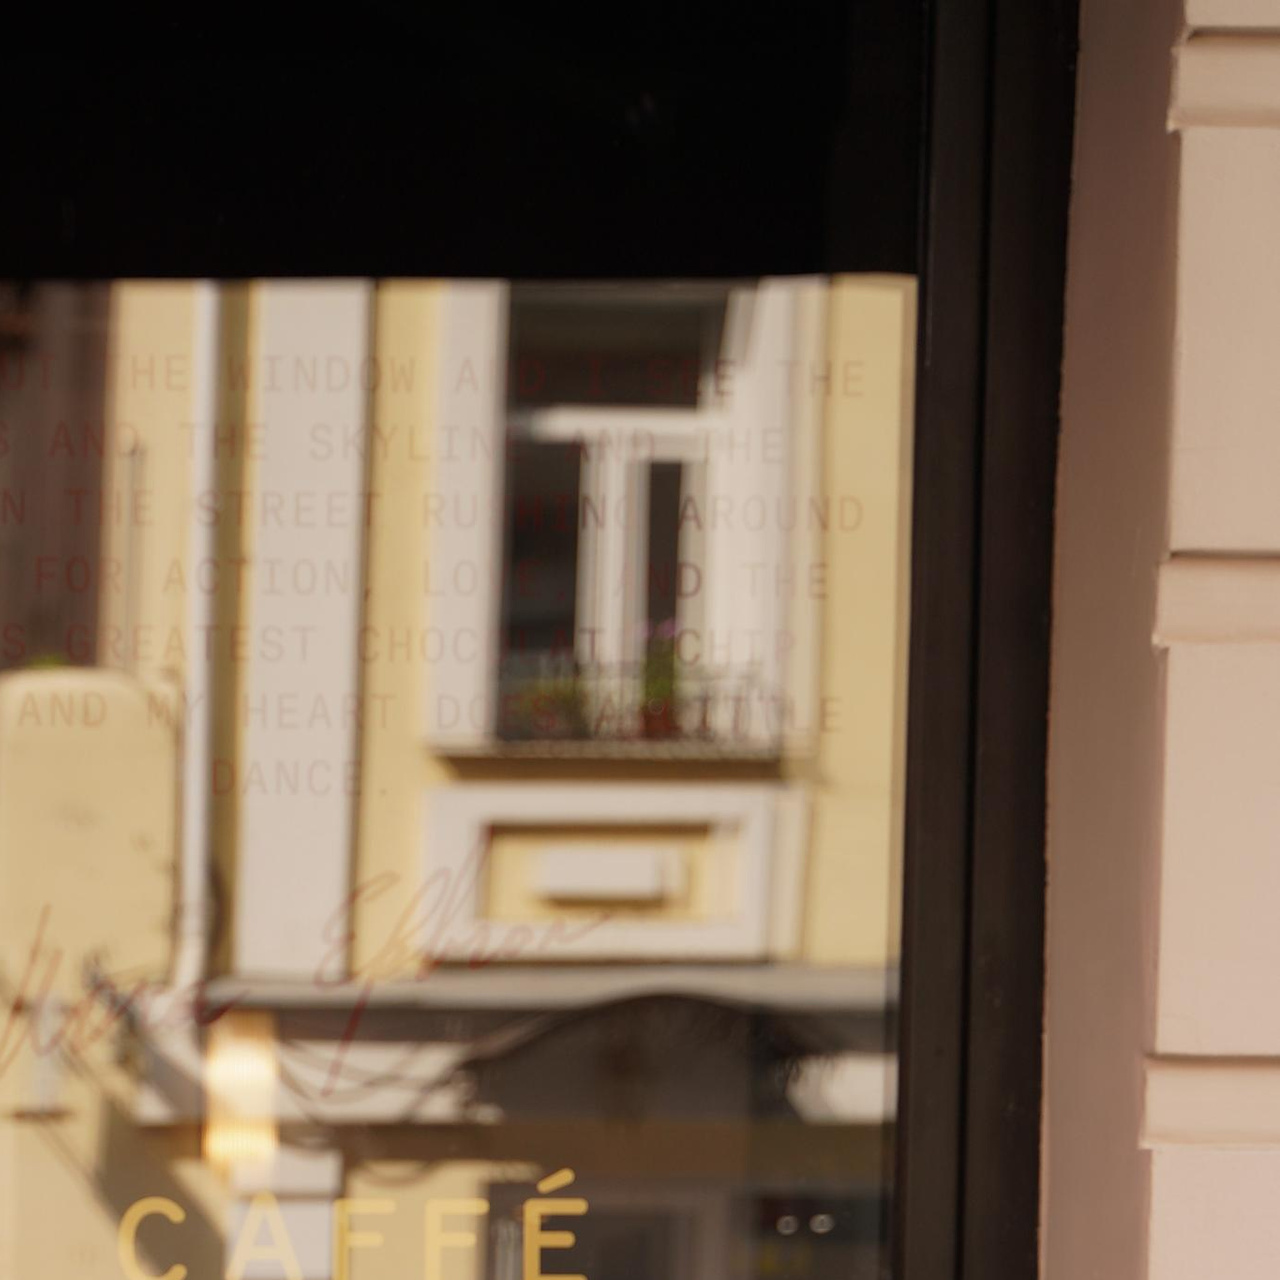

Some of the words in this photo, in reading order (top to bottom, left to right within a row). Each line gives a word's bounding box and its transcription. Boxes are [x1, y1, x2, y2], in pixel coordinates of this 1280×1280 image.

[228, 355, 416, 394] WINDOW
[779, 360, 867, 399] THE
[48, 421, 138, 459] AND
[179, 422, 268, 461] THE
[66, 488, 154, 527] THE
[196, 489, 381, 529] STREET
[678, 495, 864, 532] AROUND
[34, 557, 122, 595] FOR
[740, 562, 828, 600] THE
[66, 623, 317, 662] GREATEST
[16, 691, 108, 729] AND
[243, 692, 398, 731] HEART
